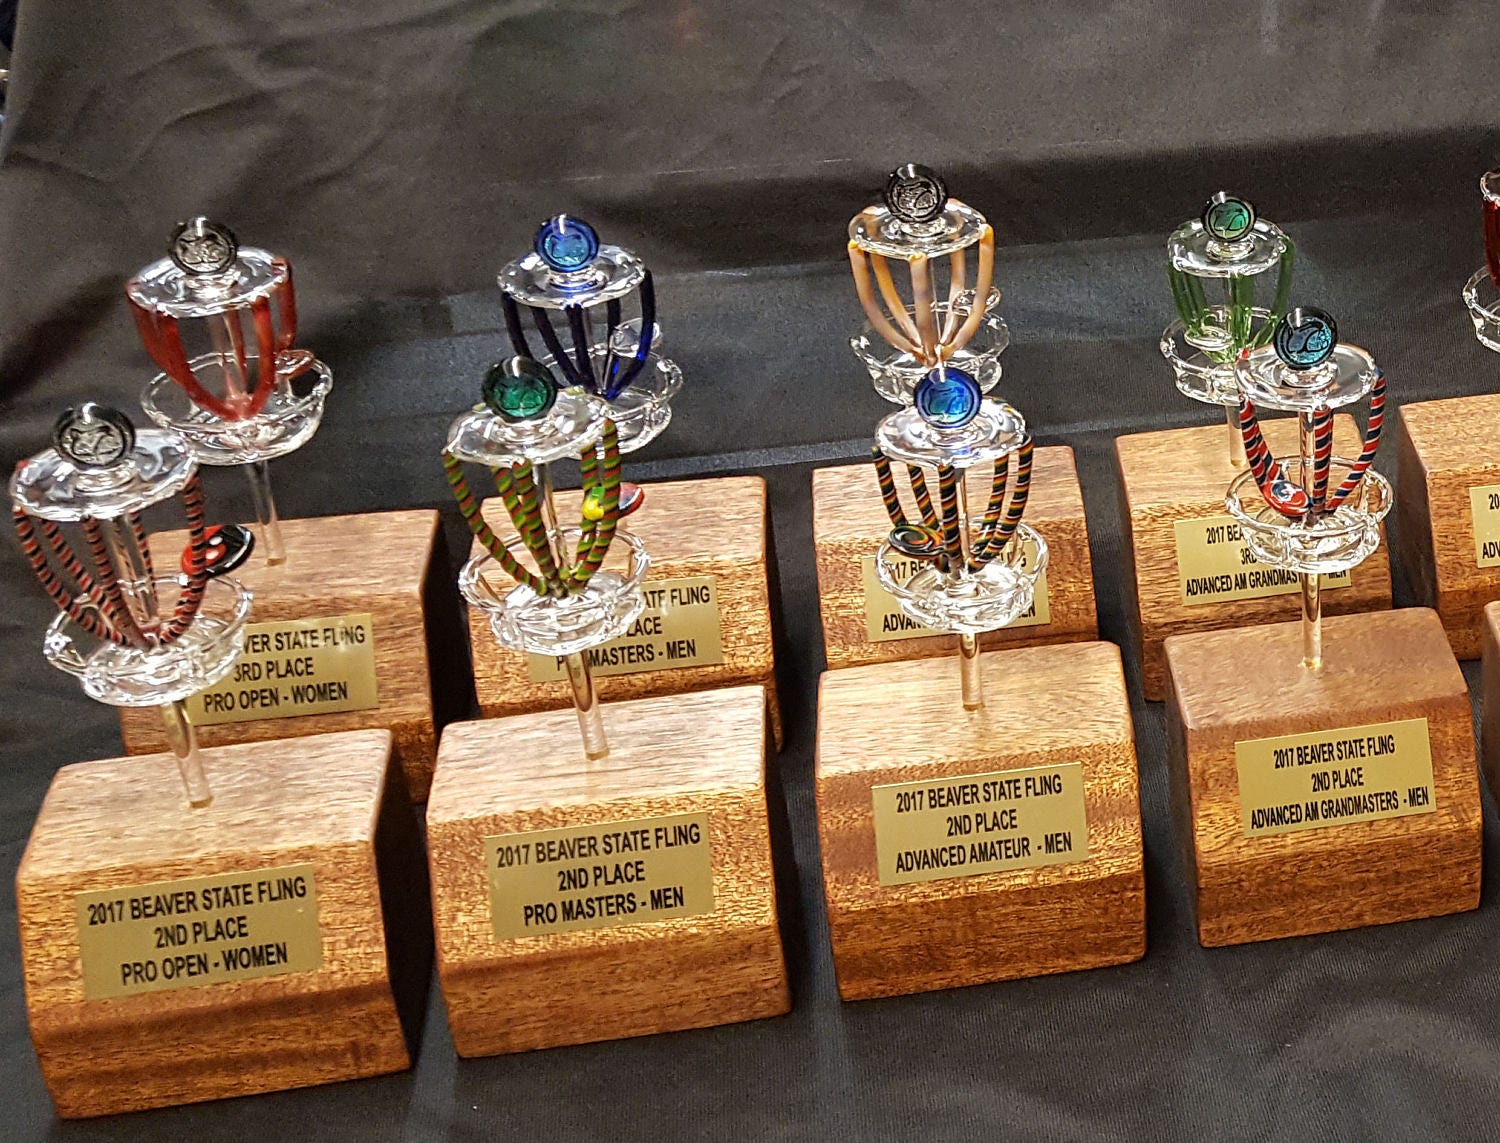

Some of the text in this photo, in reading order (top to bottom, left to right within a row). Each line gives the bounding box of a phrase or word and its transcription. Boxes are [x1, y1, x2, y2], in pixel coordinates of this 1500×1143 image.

[1206, 524, 1245, 544] 2017 BEA
[671, 586, 710, 606] FLING
[1186, 568, 1300, 596] ADVANCED AM GRANDMAS
[275, 629, 319, 651] STATE
[590, 644, 655, 667] MASTERS
[666, 639, 697, 660] MEN
[234, 657, 315, 682] 3RD PLACE
[204, 692, 235, 713] PRO
[239, 687, 279, 709] OPEN
[292, 681, 348, 704] WOMEN
[1274, 735, 1395, 769] 2017 BEAVER STATE FLING
[896, 774, 1063, 813] 2017 BEAVER STATE FLING
[1311, 767, 1364, 792] 2ND PLACE
[947, 809, 1018, 837] 2ND PLACE
[1251, 804, 1303, 829] ADVANCED
[1305, 801, 1319, 821] AM
[1321, 790, 1399, 817] GRANDMASTERS
[1408, 786, 1429, 807] MEN
[497, 823, 701, 868] 2017 BEAVER STATE FLING
[896, 845, 966, 874] ADVANCED
[970, 837, 1031, 865] AMATEUR
[1045, 832, 1072, 854] MEN
[558, 861, 645, 891] 2ND PLACE
[88, 876, 307, 925] 2017 BEAVER STATE FLING
[524, 903, 557, 926] PRO
[562, 892, 637, 922] MASTERS
[650, 886, 684, 910] MEN
[154, 916, 248, 948] 2ND PLACE
[121, 960, 157, 985] PRO
[162, 953, 209, 979] OPEN
[222, 942, 288, 971] WOMEN
